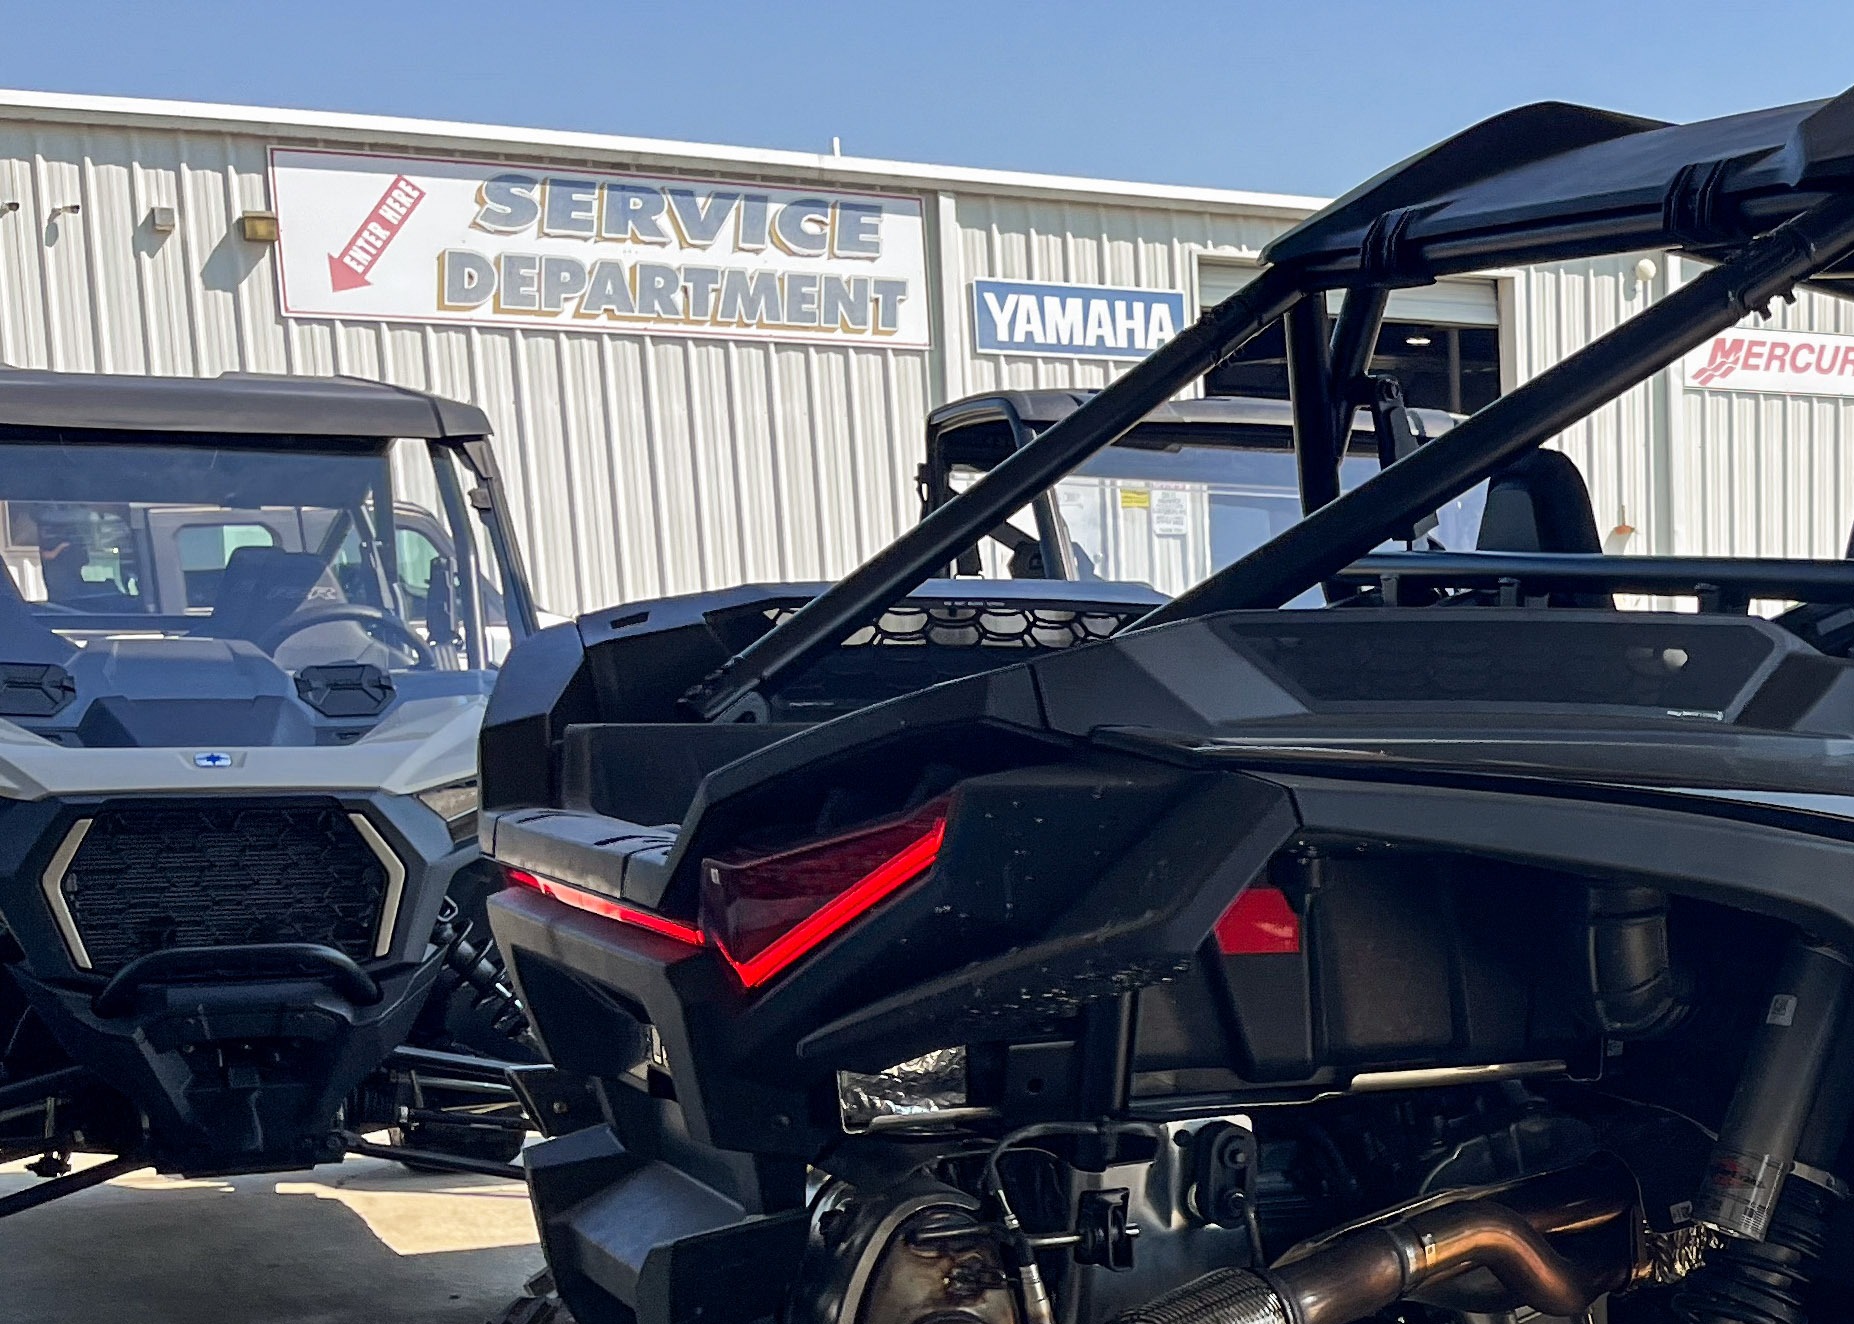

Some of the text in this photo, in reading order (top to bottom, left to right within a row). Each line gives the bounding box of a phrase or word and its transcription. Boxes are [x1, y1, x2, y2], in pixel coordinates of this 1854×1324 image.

[342, 180, 421, 274] ENTER HERE
[471, 173, 884, 260] SERVICE
[438, 248, 909, 336] DEPARTMENT
[983, 292, 1177, 350] YAMAHA
